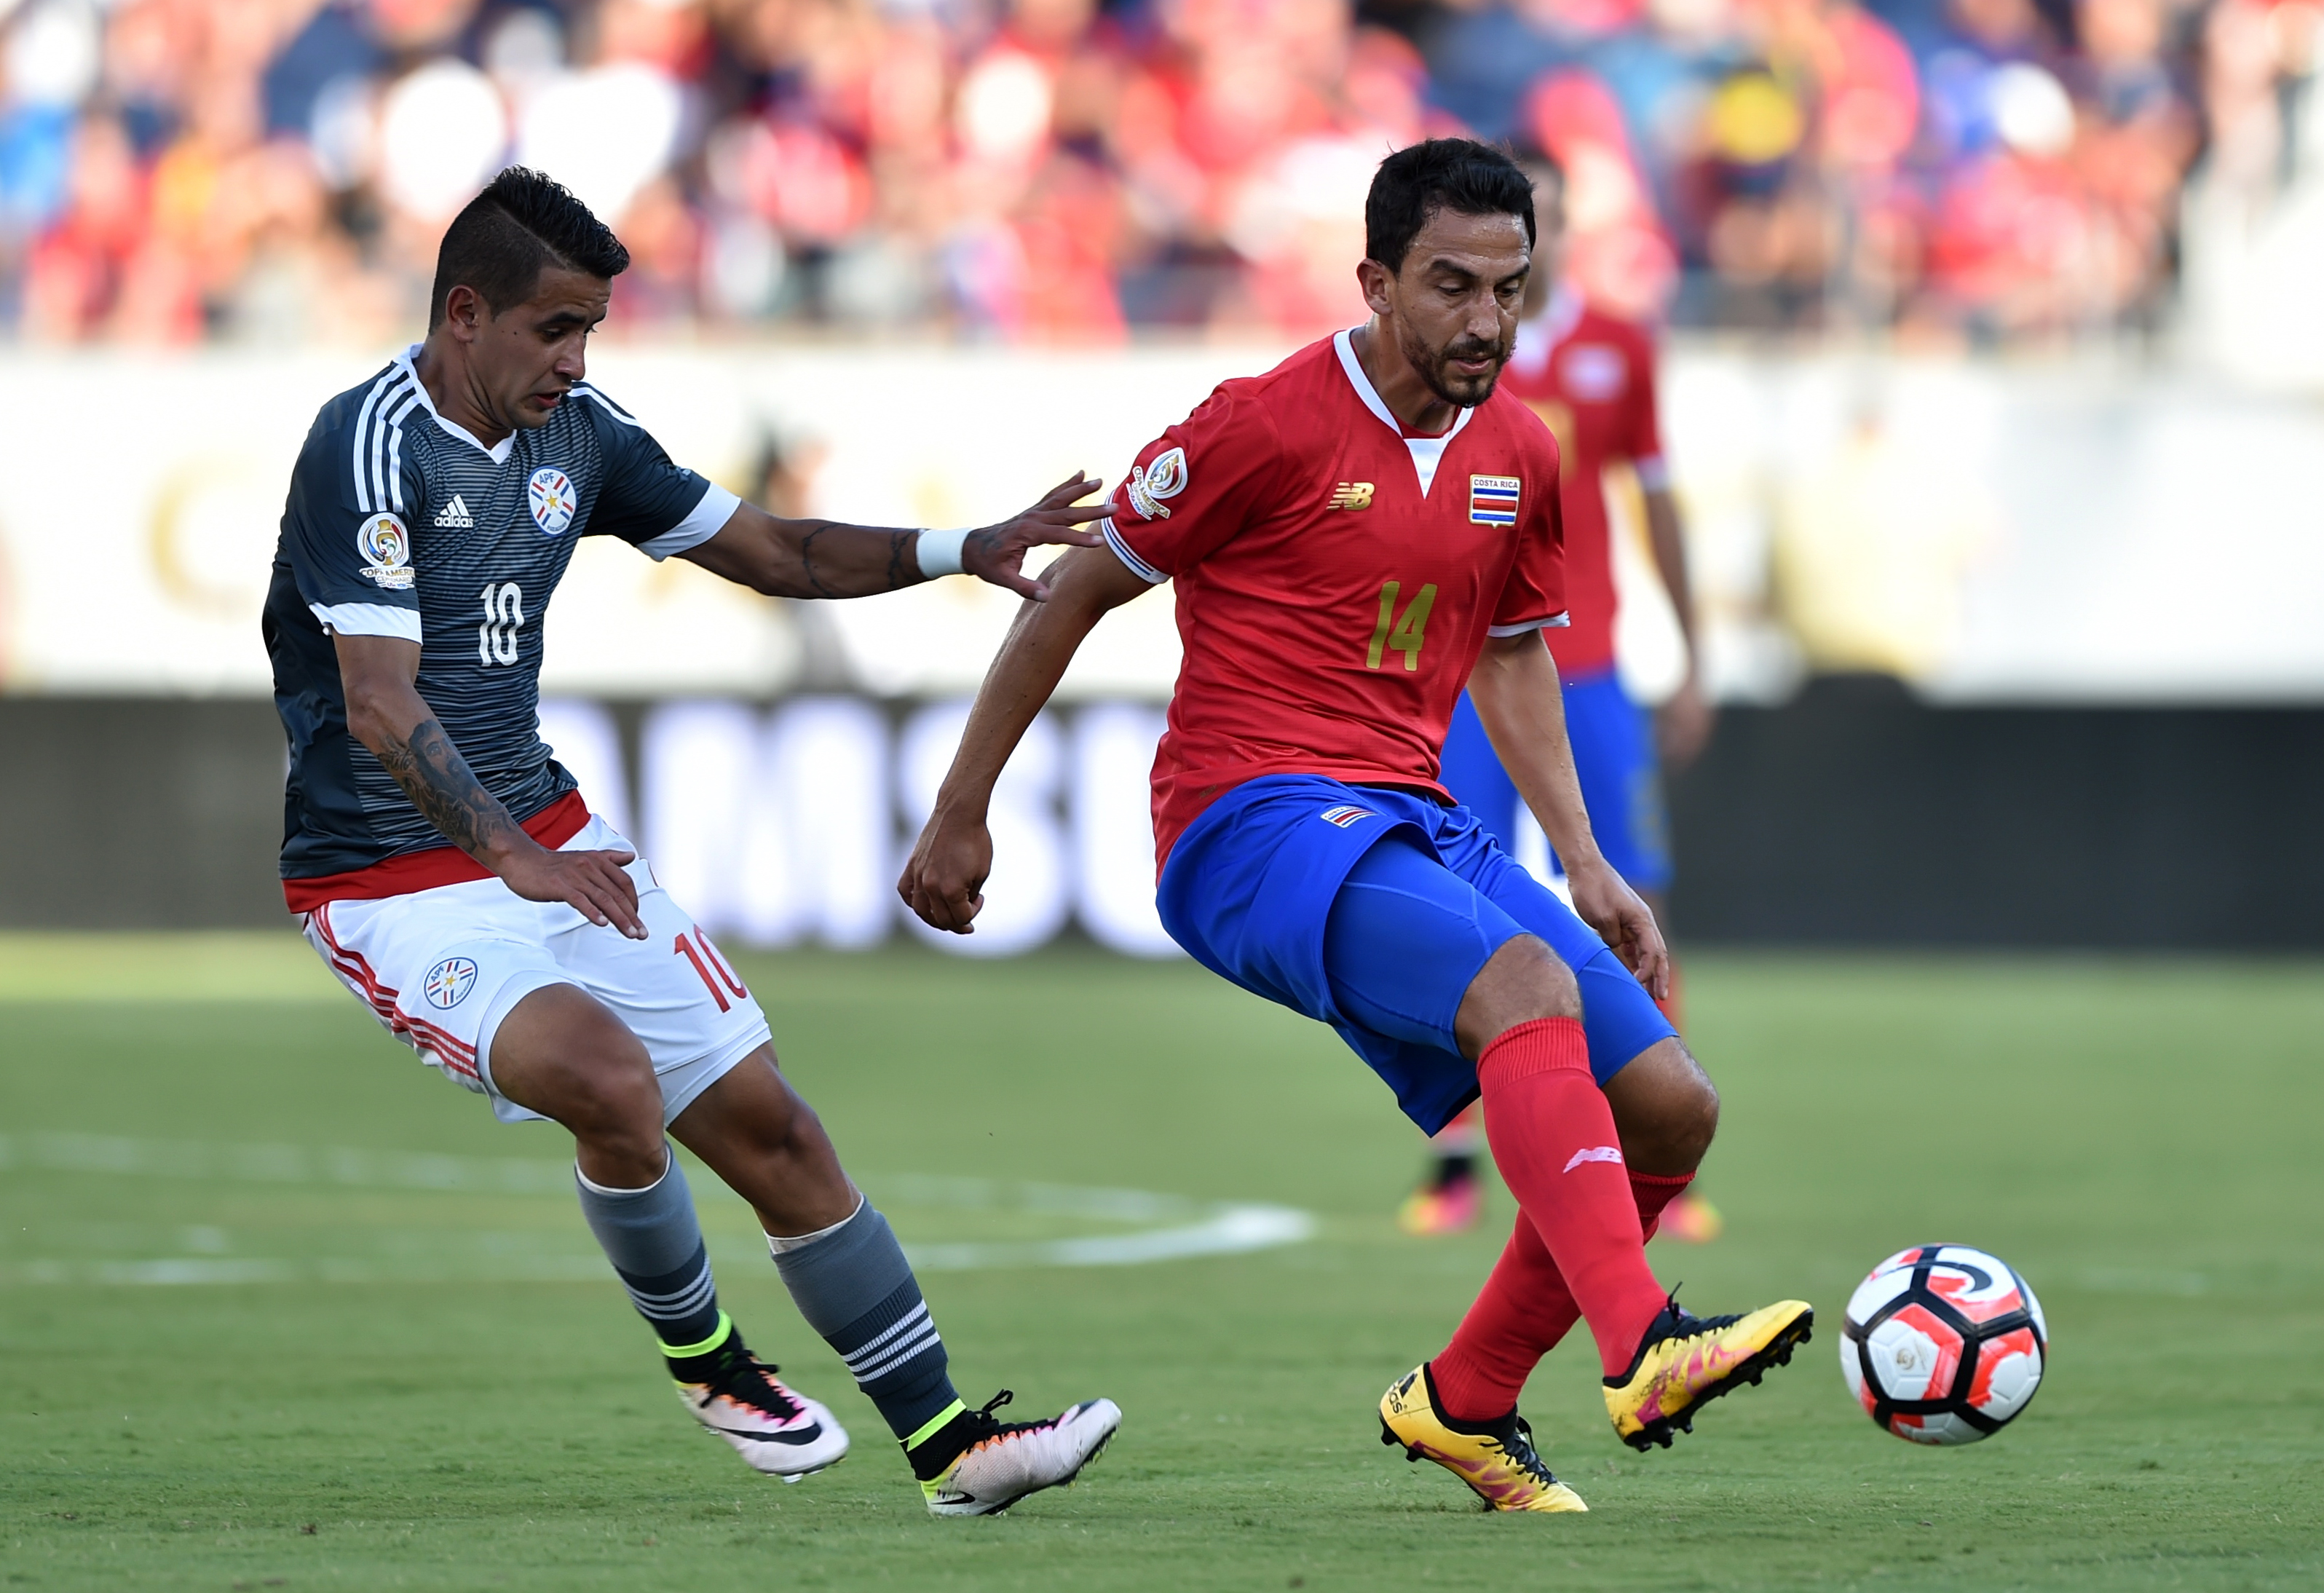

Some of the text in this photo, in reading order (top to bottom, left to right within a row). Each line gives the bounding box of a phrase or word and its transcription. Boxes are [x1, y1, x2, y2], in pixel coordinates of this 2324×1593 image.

[540, 471, 555, 485] APF
[1474, 479, 1518, 489] COSTA RICA
[434, 513, 474, 528] adidas
[479, 582, 524, 666] 10
[1366, 580, 1437, 671] 14
[430, 965, 445, 983] APF
[673, 922, 747, 1013] 10
